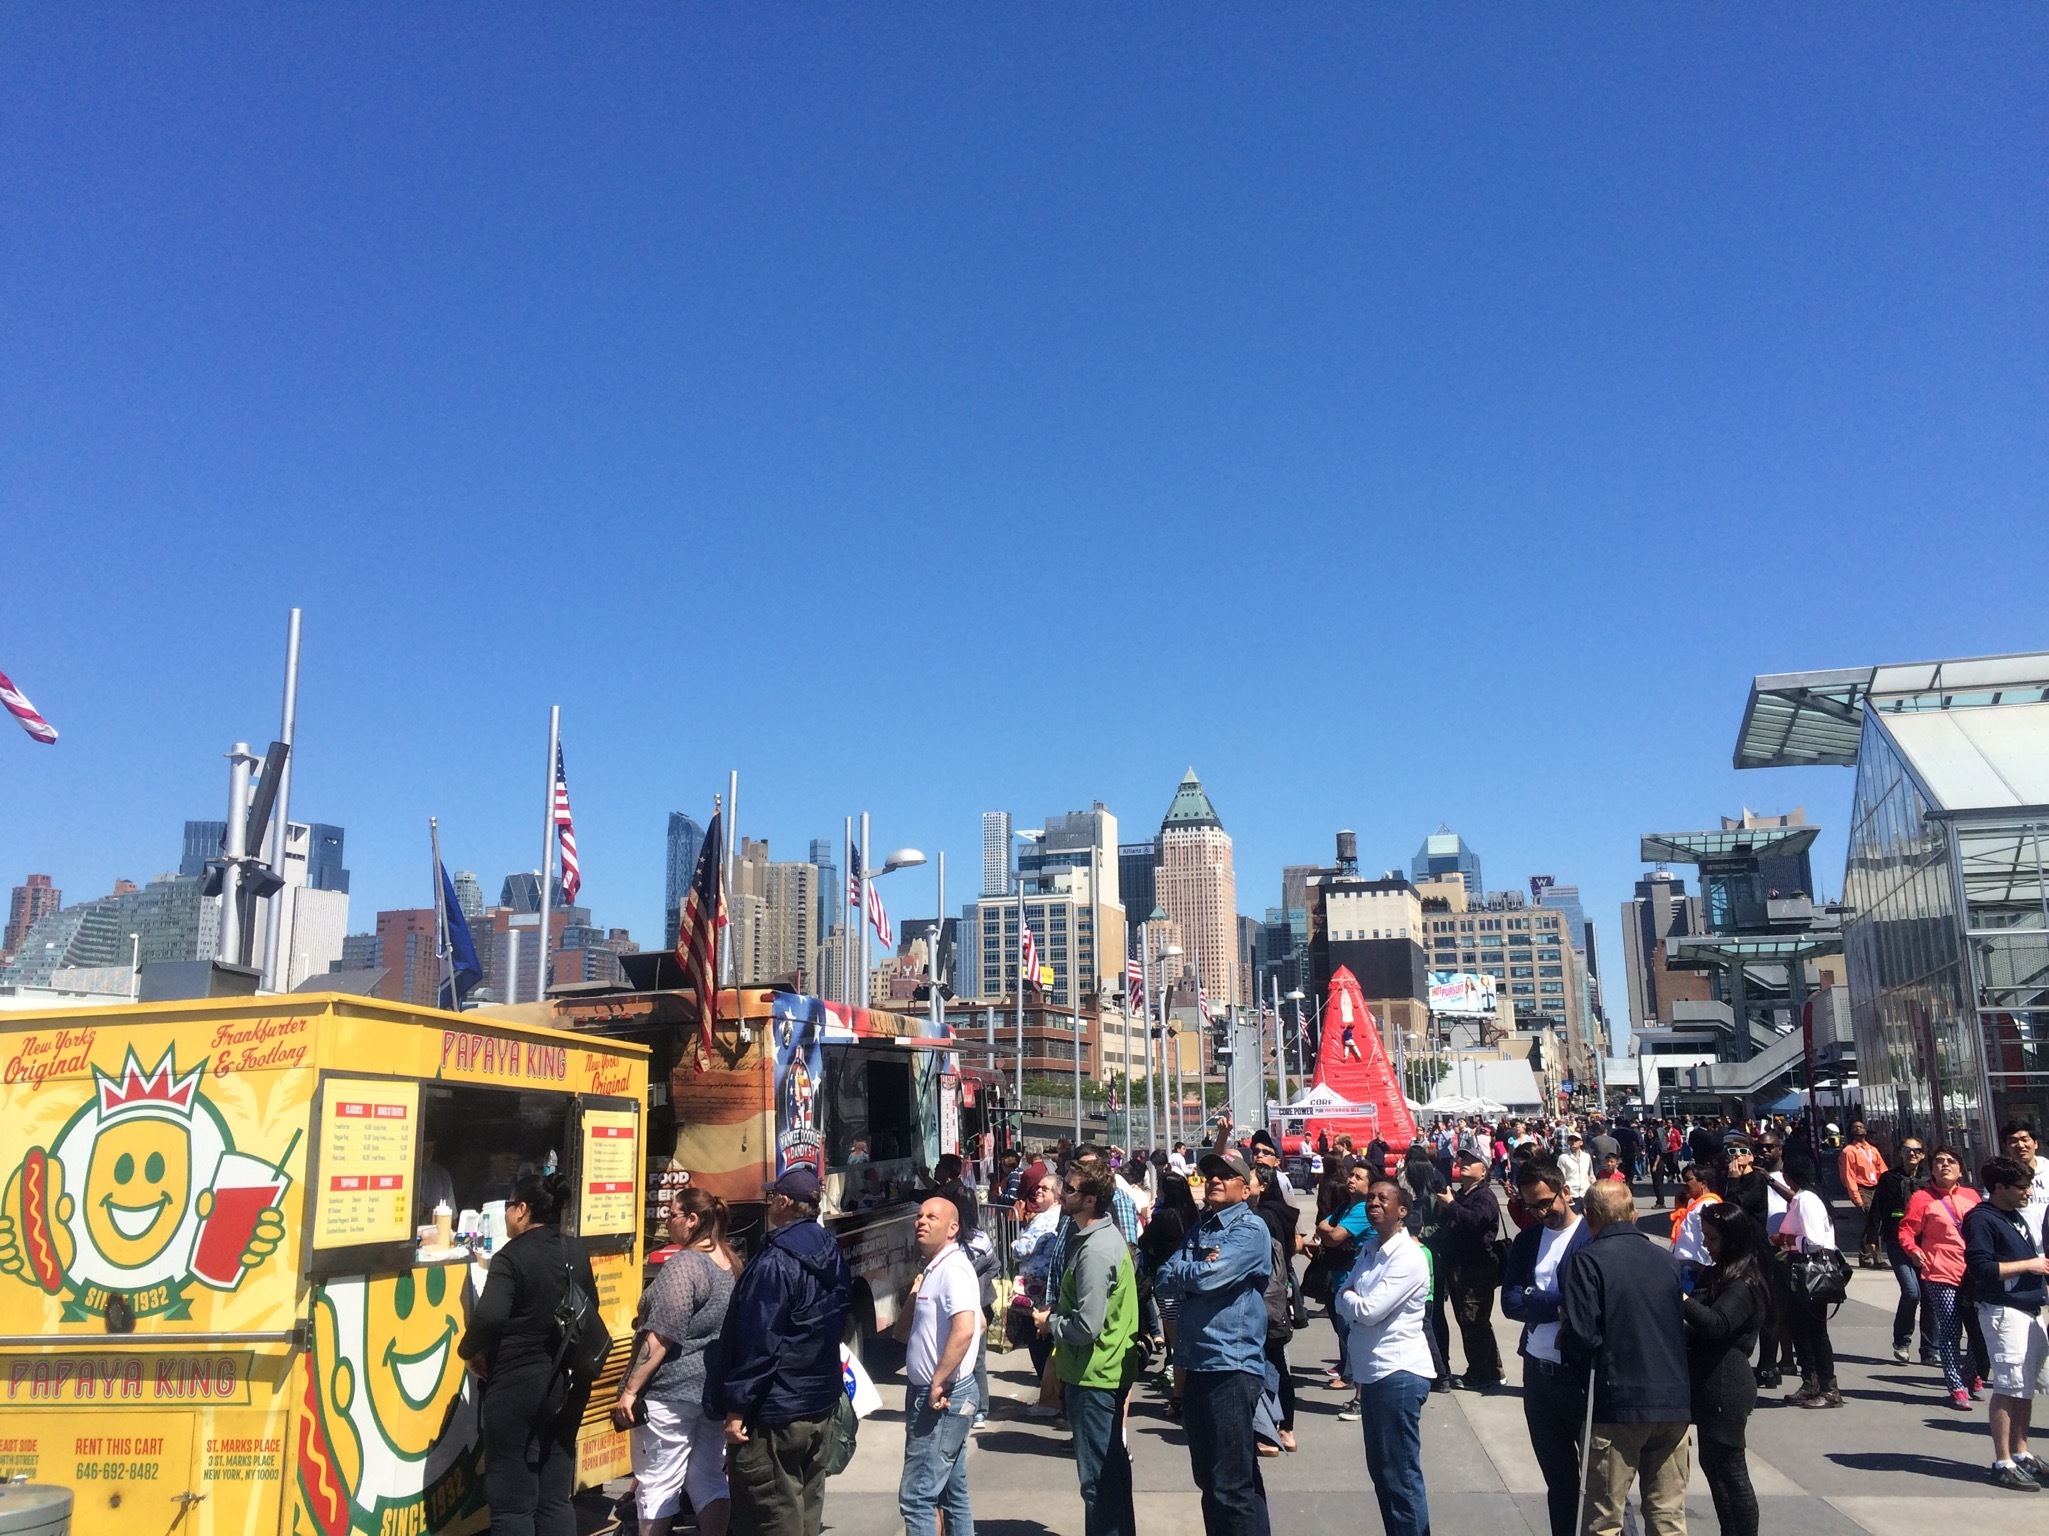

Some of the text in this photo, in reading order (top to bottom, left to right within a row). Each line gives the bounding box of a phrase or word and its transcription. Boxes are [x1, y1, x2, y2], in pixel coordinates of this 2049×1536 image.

[1535, 878, 1548, 887] W
[211, 1016, 307, 1049] Frankfurter
[21, 1026, 97, 1061] New York's
[213, 1040, 308, 1079] & Footlong
[441, 1030, 567, 1081] PAPAYA KING
[585, 1053, 600, 1072] New
[3, 1046, 96, 1092] Original
[592, 1063, 632, 1095] Original
[1278, 1107, 1293, 1116] CORE
[1293, 1106, 1314, 1116] POWER
[780, 1129, 801, 1147] YANKEE
[649, 1171, 690, 1185] FOOD
[133, 1285, 170, 1313] 1932
[7, 1358, 236, 1399] PAPAYA KING
[19, 1439, 38, 1452] SIDE
[75, 1437, 164, 1456] RENT THIS CART
[206, 1438, 281, 1453] ST. MARKS PLACE
[14, 1455, 39, 1466] STREET
[208, 1454, 276, 1467] 3 ST. MARKS PLACE
[76, 1462, 160, 1480] 646-692-8482
[203, 1468, 280, 1482] NEW YORK, NY 10003
[380, 1500, 427, 1536] SINCE
